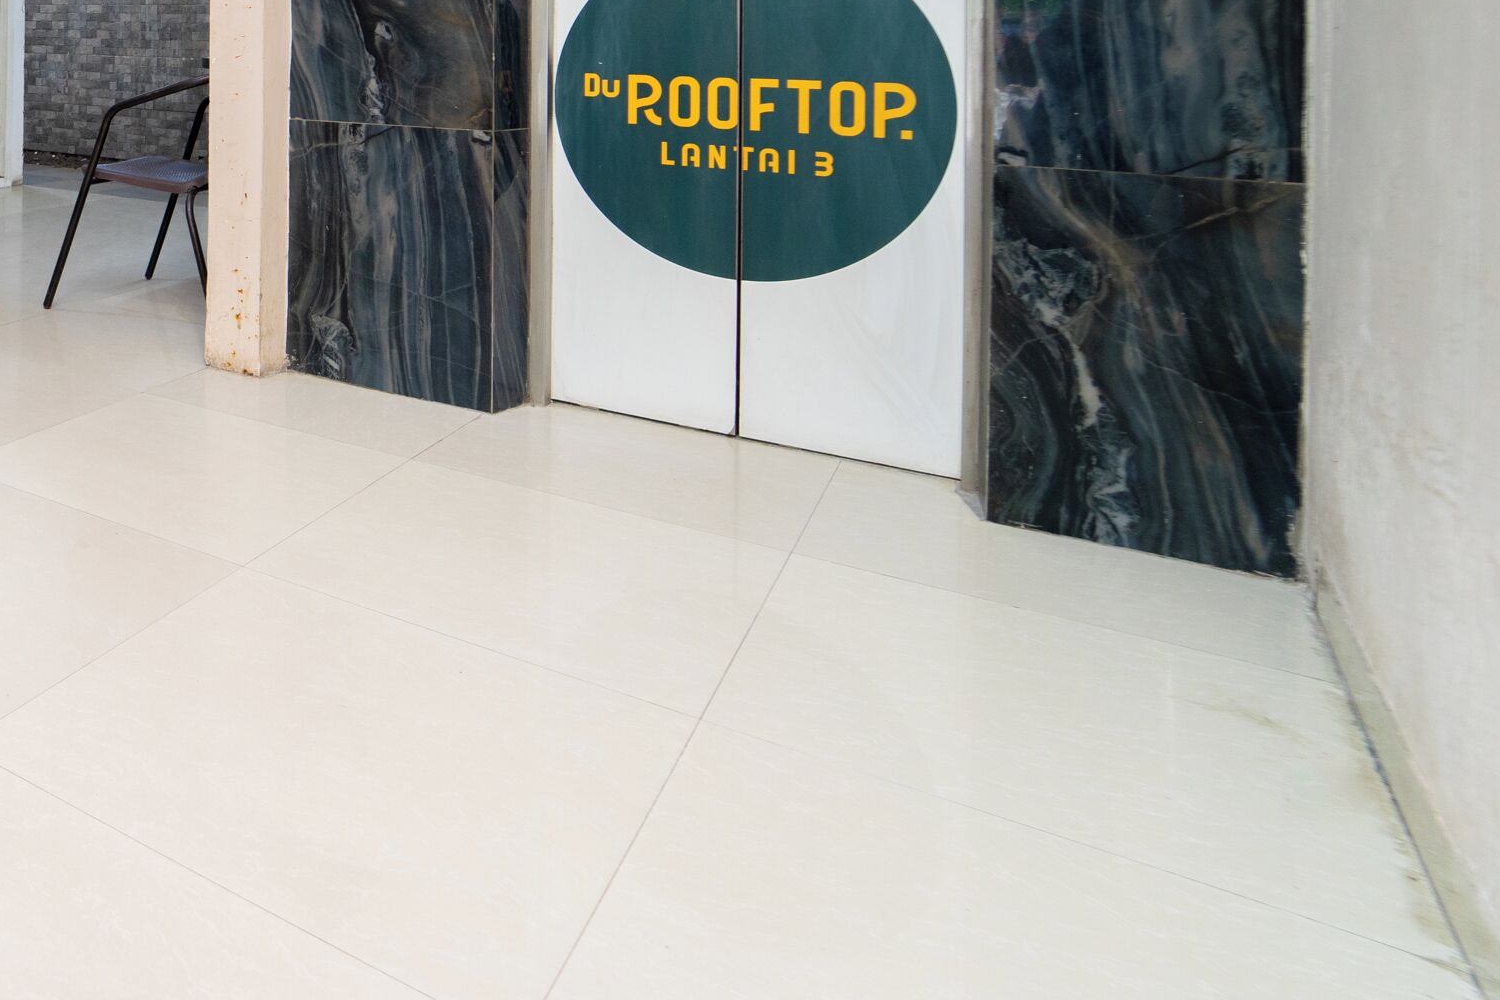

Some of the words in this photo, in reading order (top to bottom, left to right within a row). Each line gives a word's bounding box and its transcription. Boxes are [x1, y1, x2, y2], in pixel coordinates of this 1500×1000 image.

[627, 74, 917, 140] ROOFTOP.
[660, 141, 796, 175] LANTAI
[814, 151, 835, 178] 3
